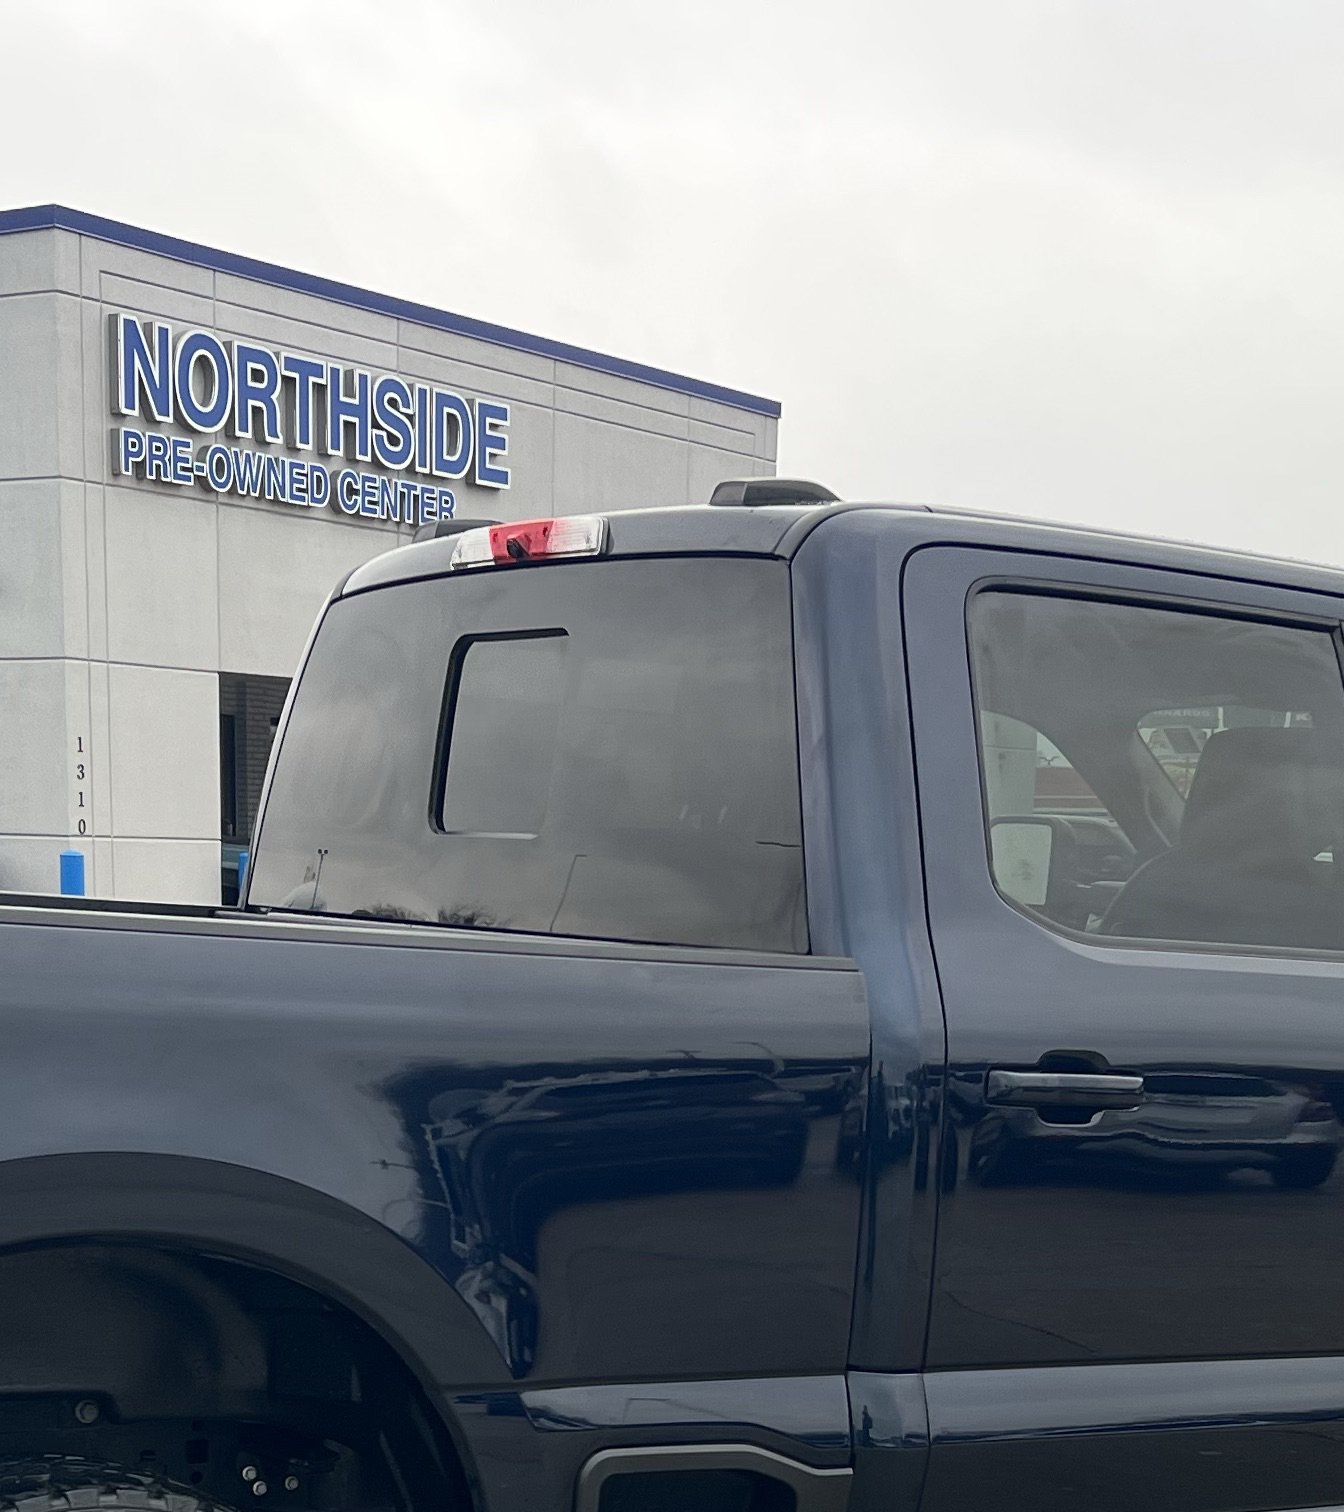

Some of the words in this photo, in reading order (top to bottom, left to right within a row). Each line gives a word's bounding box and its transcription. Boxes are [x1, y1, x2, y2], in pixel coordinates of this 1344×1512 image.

[116, 312, 511, 490] NORTHSIDE
[121, 427, 331, 508] PRE-OWNED
[338, 468, 457, 526] CENTER
